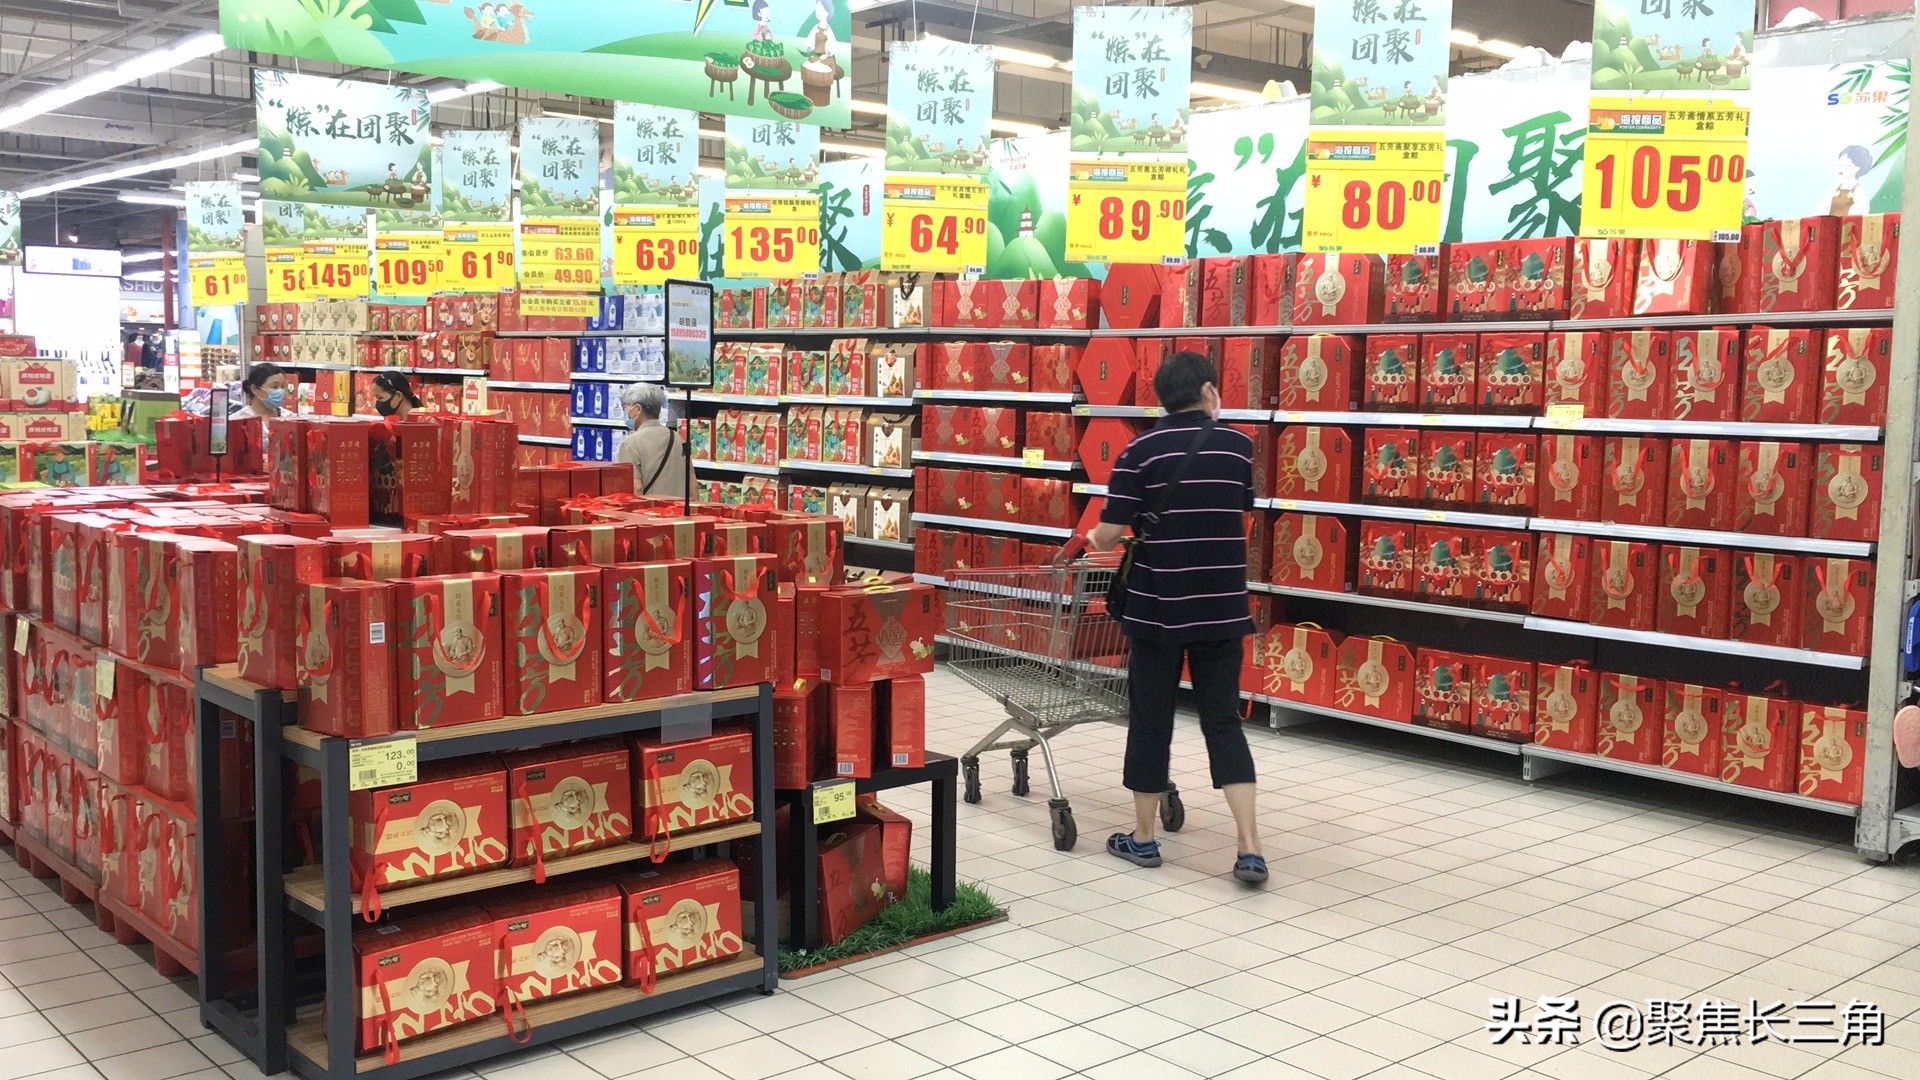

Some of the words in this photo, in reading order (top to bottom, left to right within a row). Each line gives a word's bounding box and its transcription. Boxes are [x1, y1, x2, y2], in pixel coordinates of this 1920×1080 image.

[1351, 27, 1415, 65] 团聚
[1104, 67, 1160, 99] 团聚
[1854, 90, 1888, 104] 苏果
[916, 96, 967, 126] 团聚
[1620, 114, 1662, 125] 海报商品
[1695, 121, 1715, 131] 盒粽
[636, 141, 677, 165] 团聚
[1334, 145, 1371, 155] 海报商品
[542, 159, 580, 180] 团聚
[1093, 168, 1124, 177] 海报商品
[1311, 175, 1321, 188] ¥
[1072, 194, 1081, 206] ¥
[886, 212, 895, 227] ¥
[555, 247, 594, 261] 63.60
[555, 269, 593, 283] 49.90
[1279, 343, 1305, 408] 五芳
[1277, 432, 1302, 496] 五芳
[1263, 632, 1289, 694] 五芳
